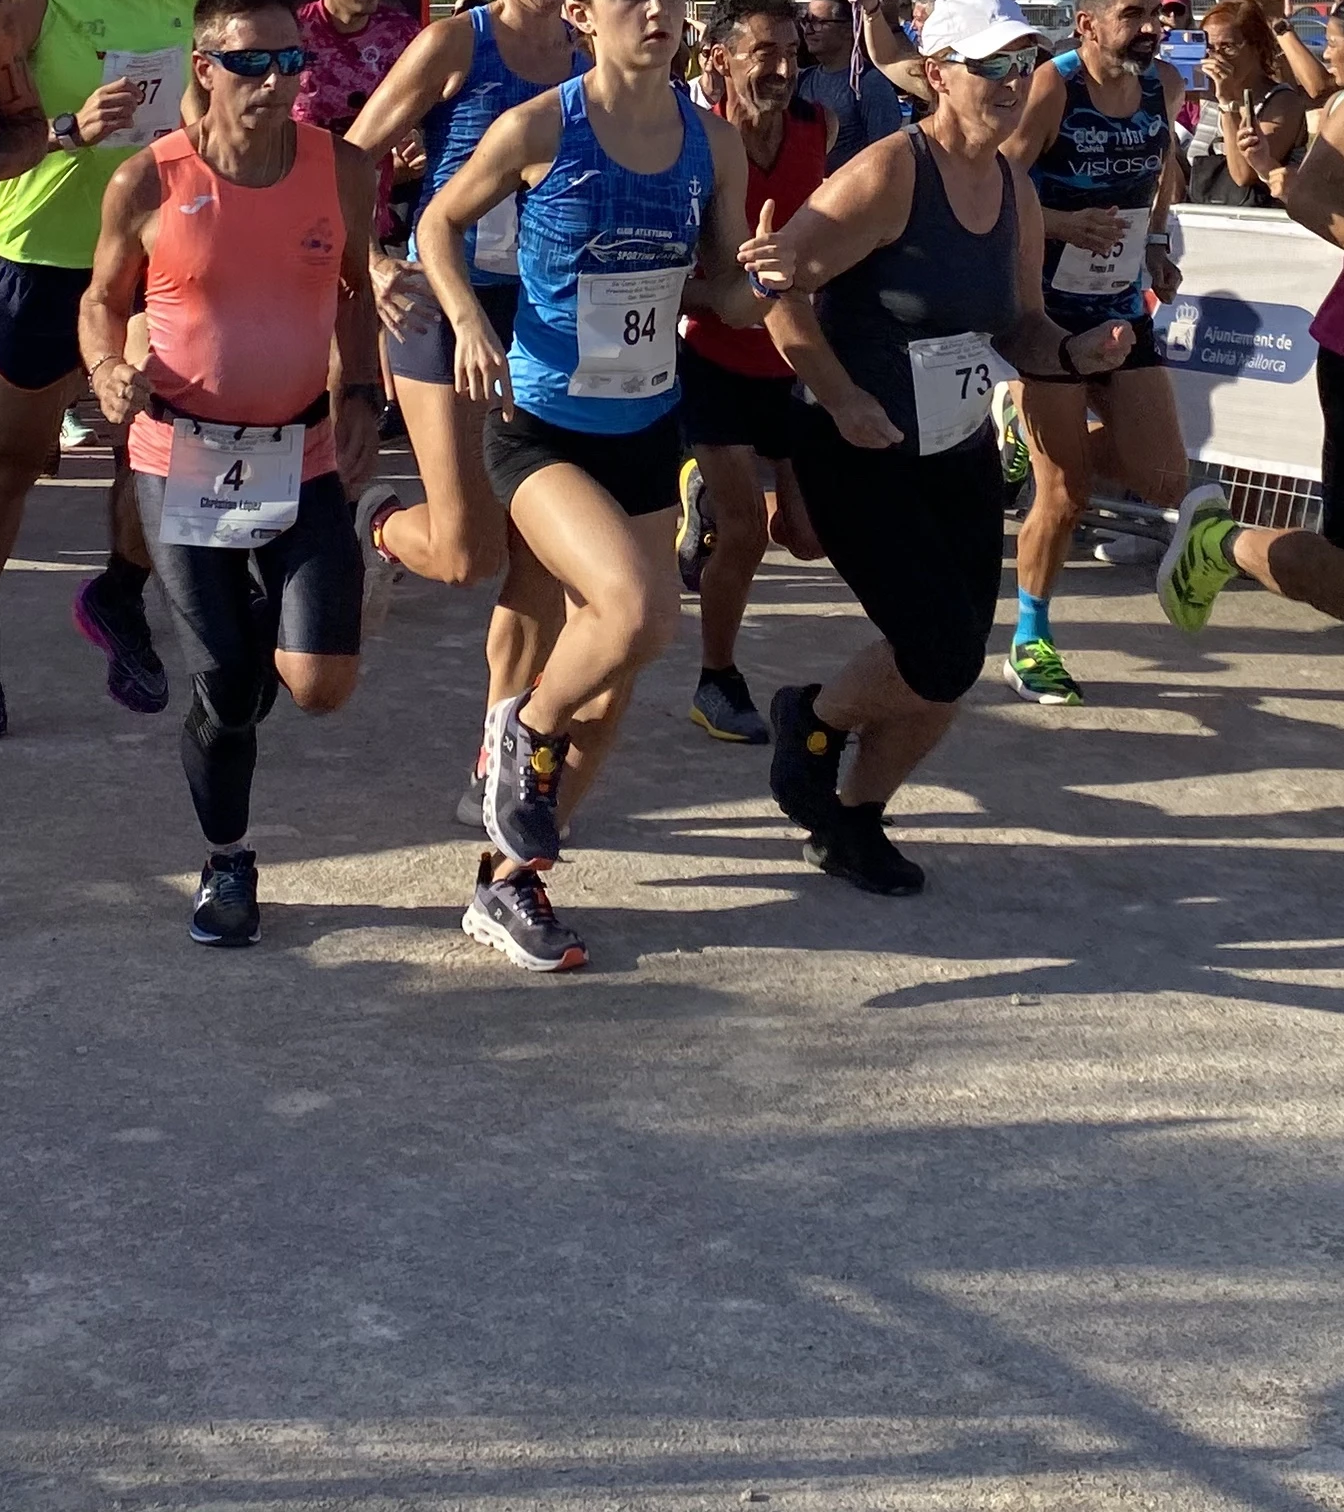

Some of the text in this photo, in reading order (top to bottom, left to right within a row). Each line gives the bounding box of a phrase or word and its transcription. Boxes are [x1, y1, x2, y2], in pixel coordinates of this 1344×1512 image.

[623, 307, 656, 346] 84
[1204, 326, 1293, 351] Ajuntament de
[1238, 352, 1287, 373] Mallorca
[955, 363, 993, 400] 73
[223, 459, 244, 492] 4
